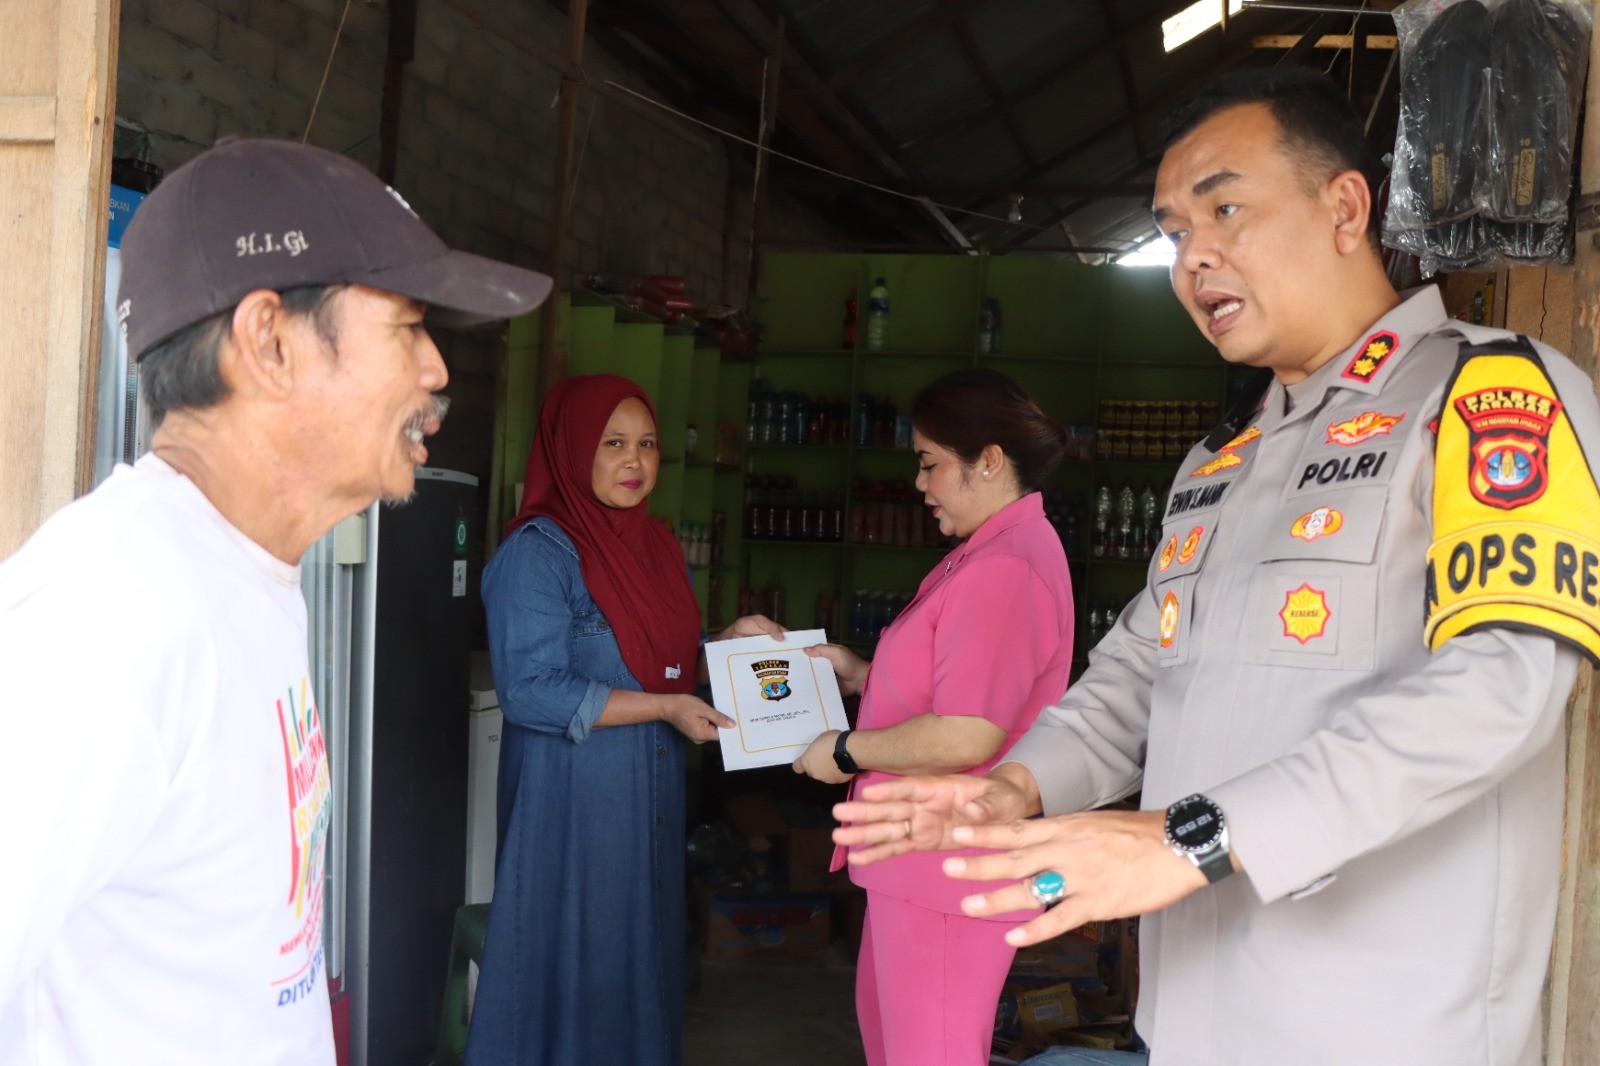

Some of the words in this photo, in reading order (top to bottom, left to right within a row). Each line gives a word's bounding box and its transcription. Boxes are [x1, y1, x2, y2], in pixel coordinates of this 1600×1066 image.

[110, 198, 130, 212] BKAN
[1297, 451, 1388, 490] POLRI
[1448, 533, 1537, 594] OPS
[1554, 541, 1600, 607] RE
